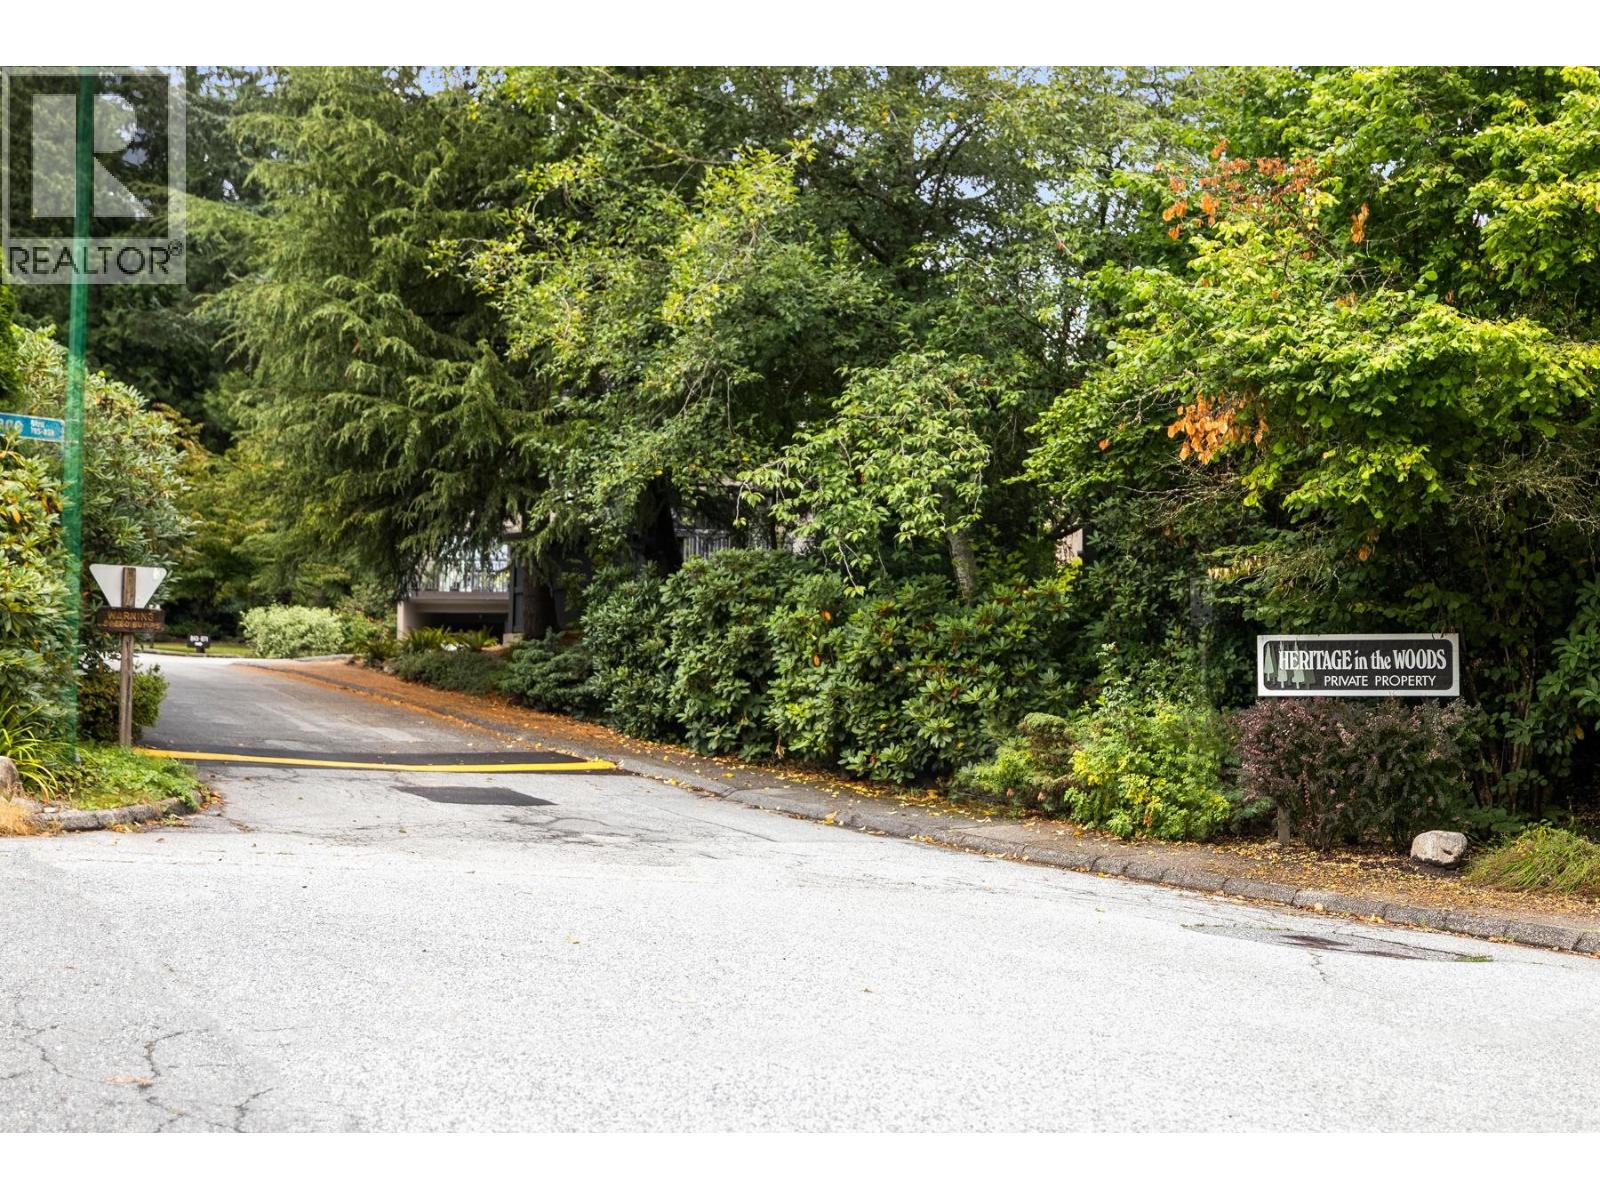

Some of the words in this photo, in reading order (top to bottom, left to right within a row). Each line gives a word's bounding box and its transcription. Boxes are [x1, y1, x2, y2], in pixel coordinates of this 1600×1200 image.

[107, 611, 154, 621] WARNING
[1279, 649, 1352, 670] HERITAGE
[1355, 650, 1368, 670] in
[1370, 650, 1391, 670] the
[1392, 648, 1447, 670] WOODS
[1324, 675, 1369, 687] PRIVATE
[1374, 675, 1437, 687] PROPERTY
